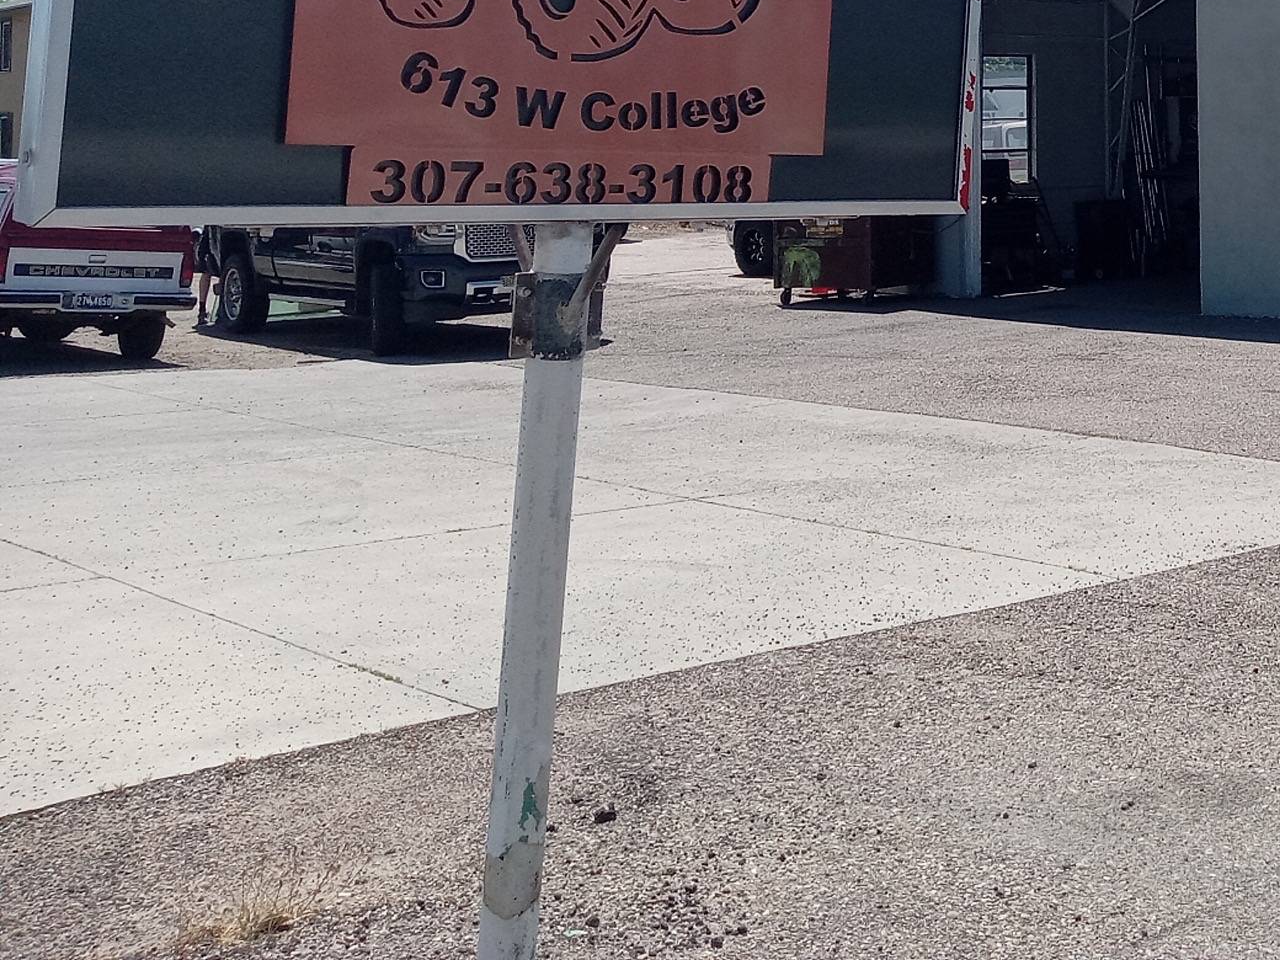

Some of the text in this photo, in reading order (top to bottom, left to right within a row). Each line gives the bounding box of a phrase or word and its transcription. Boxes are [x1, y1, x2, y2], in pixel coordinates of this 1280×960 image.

[400, 52, 766, 133] 613 W College
[371, 160, 752, 204] 307-638-3108
[29, 265, 160, 278] CHEVROLET
